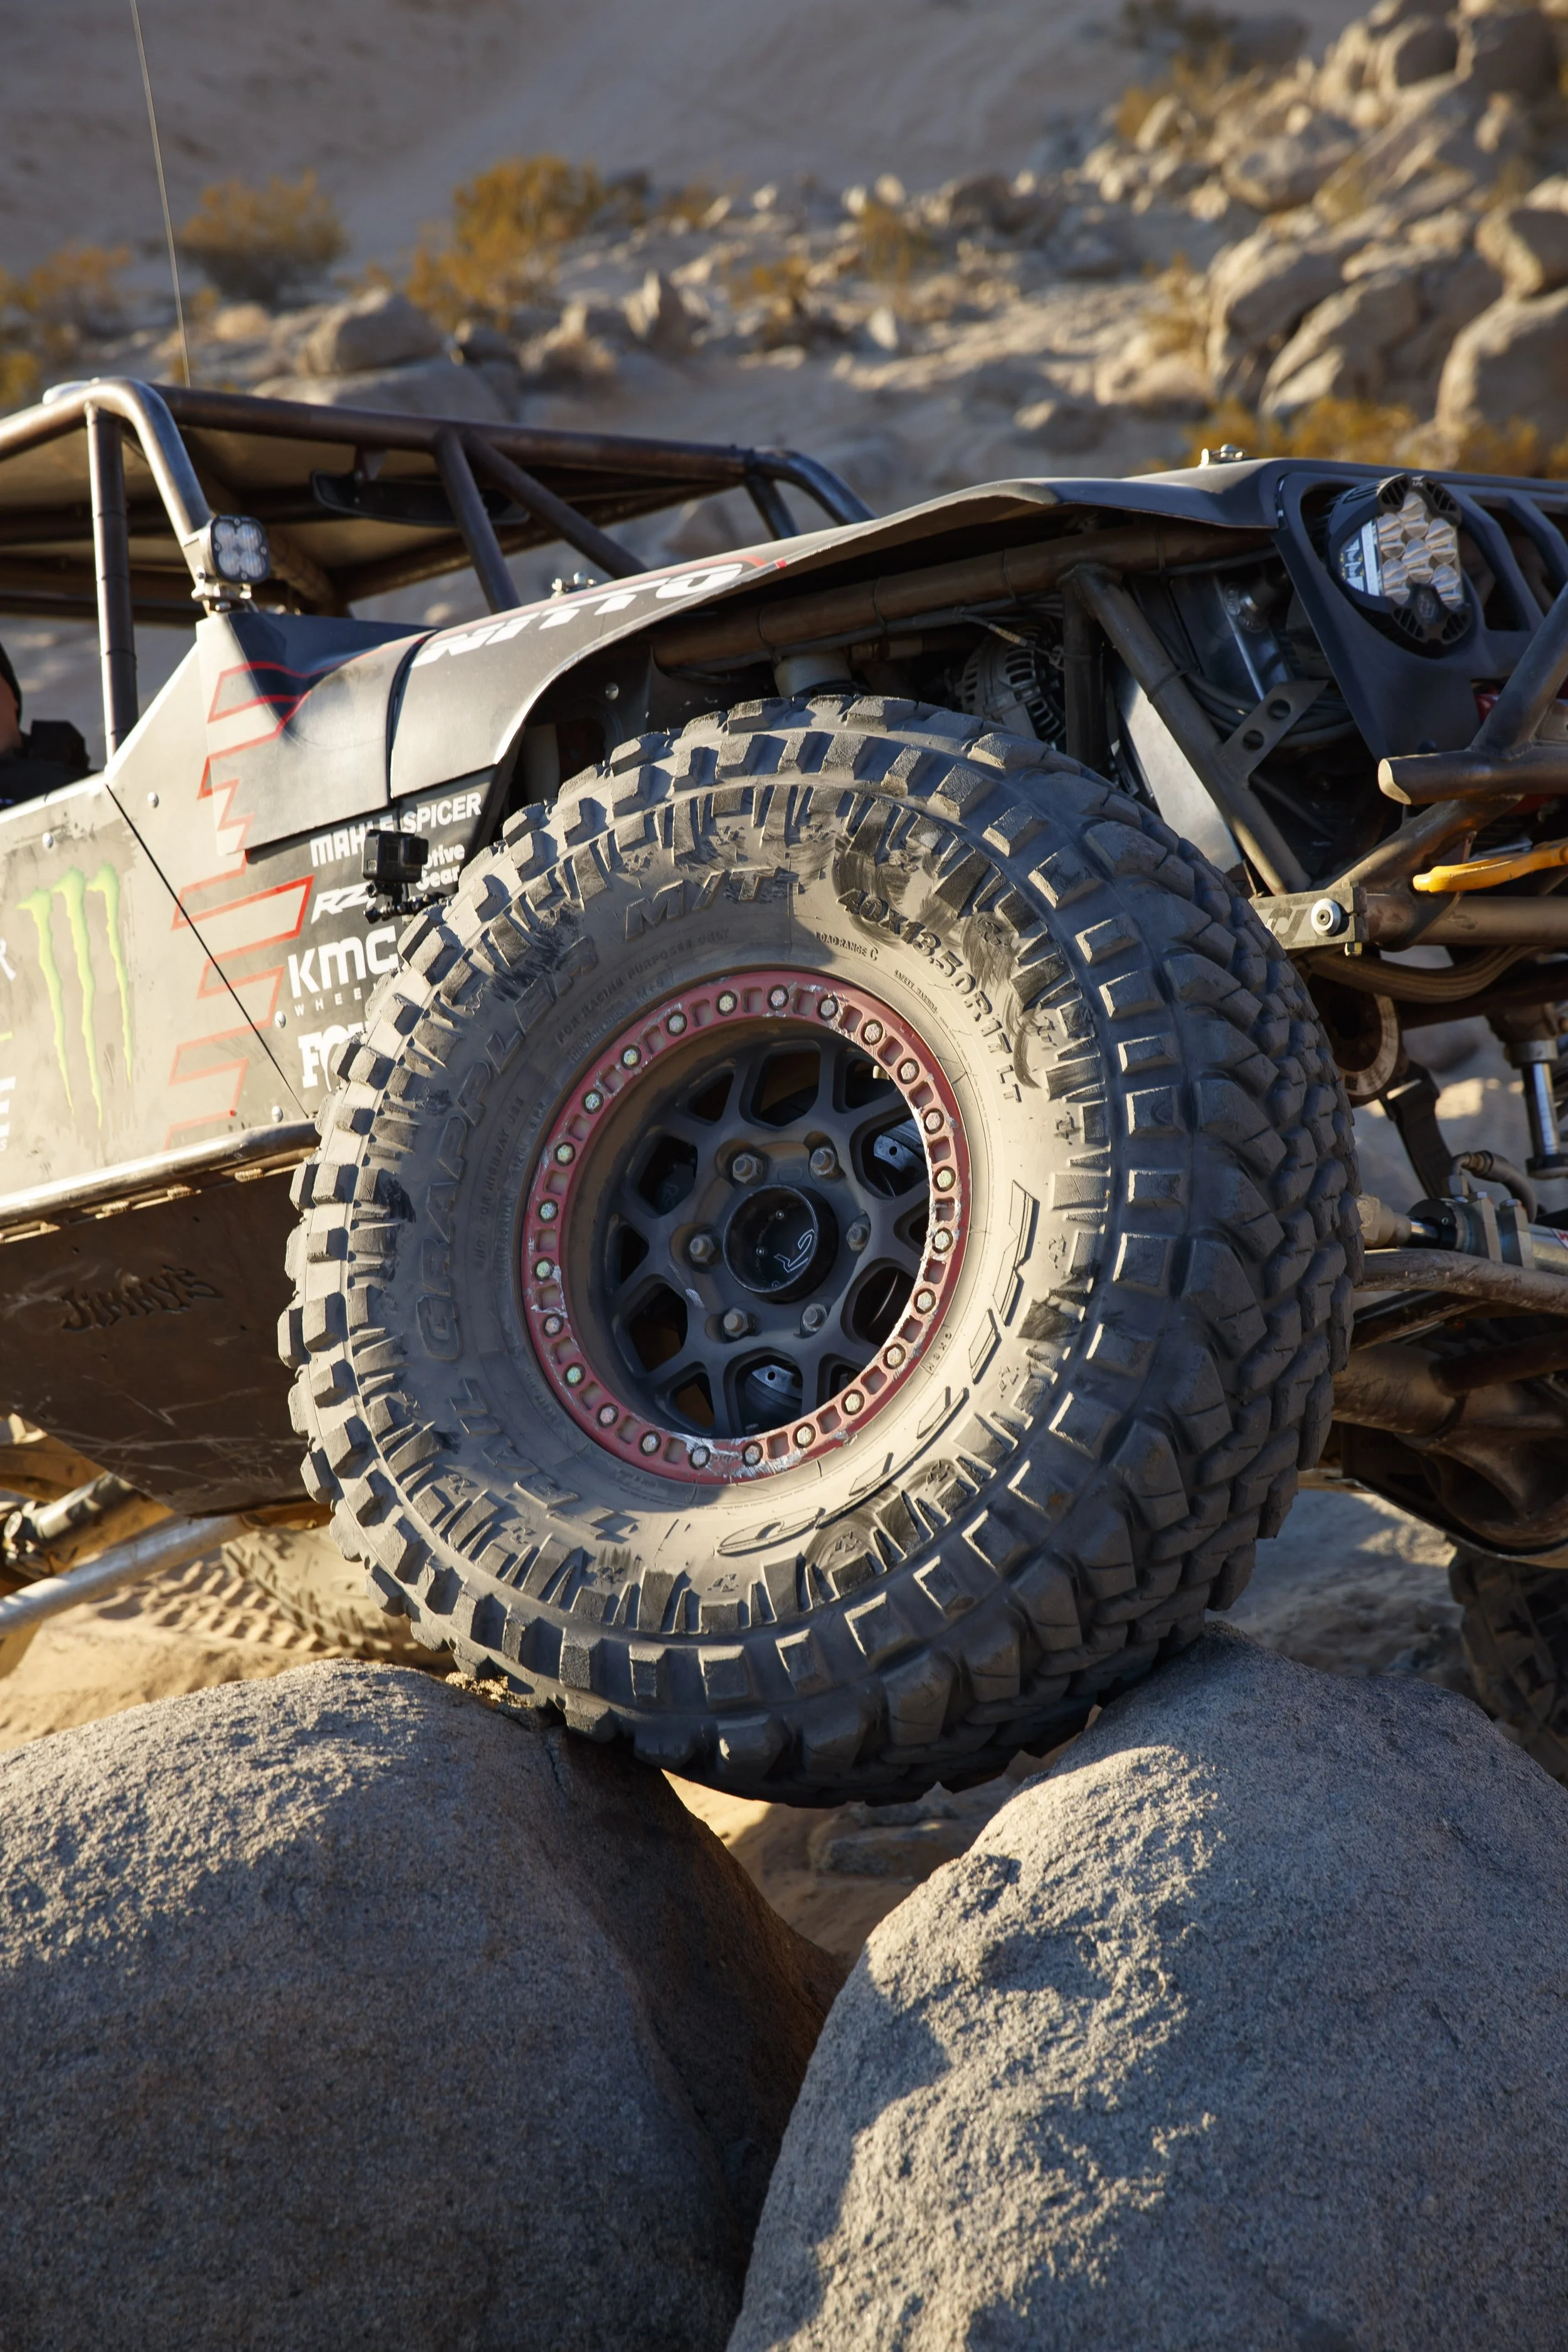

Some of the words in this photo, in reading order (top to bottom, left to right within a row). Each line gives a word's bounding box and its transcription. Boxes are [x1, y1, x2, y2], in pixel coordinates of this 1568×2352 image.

[411, 563, 744, 669] NITTO
[402, 792, 482, 834] SPICER
[311, 881, 378, 924] RZ
[288, 925, 399, 999] KMC
[870, 946, 879, 961] C
